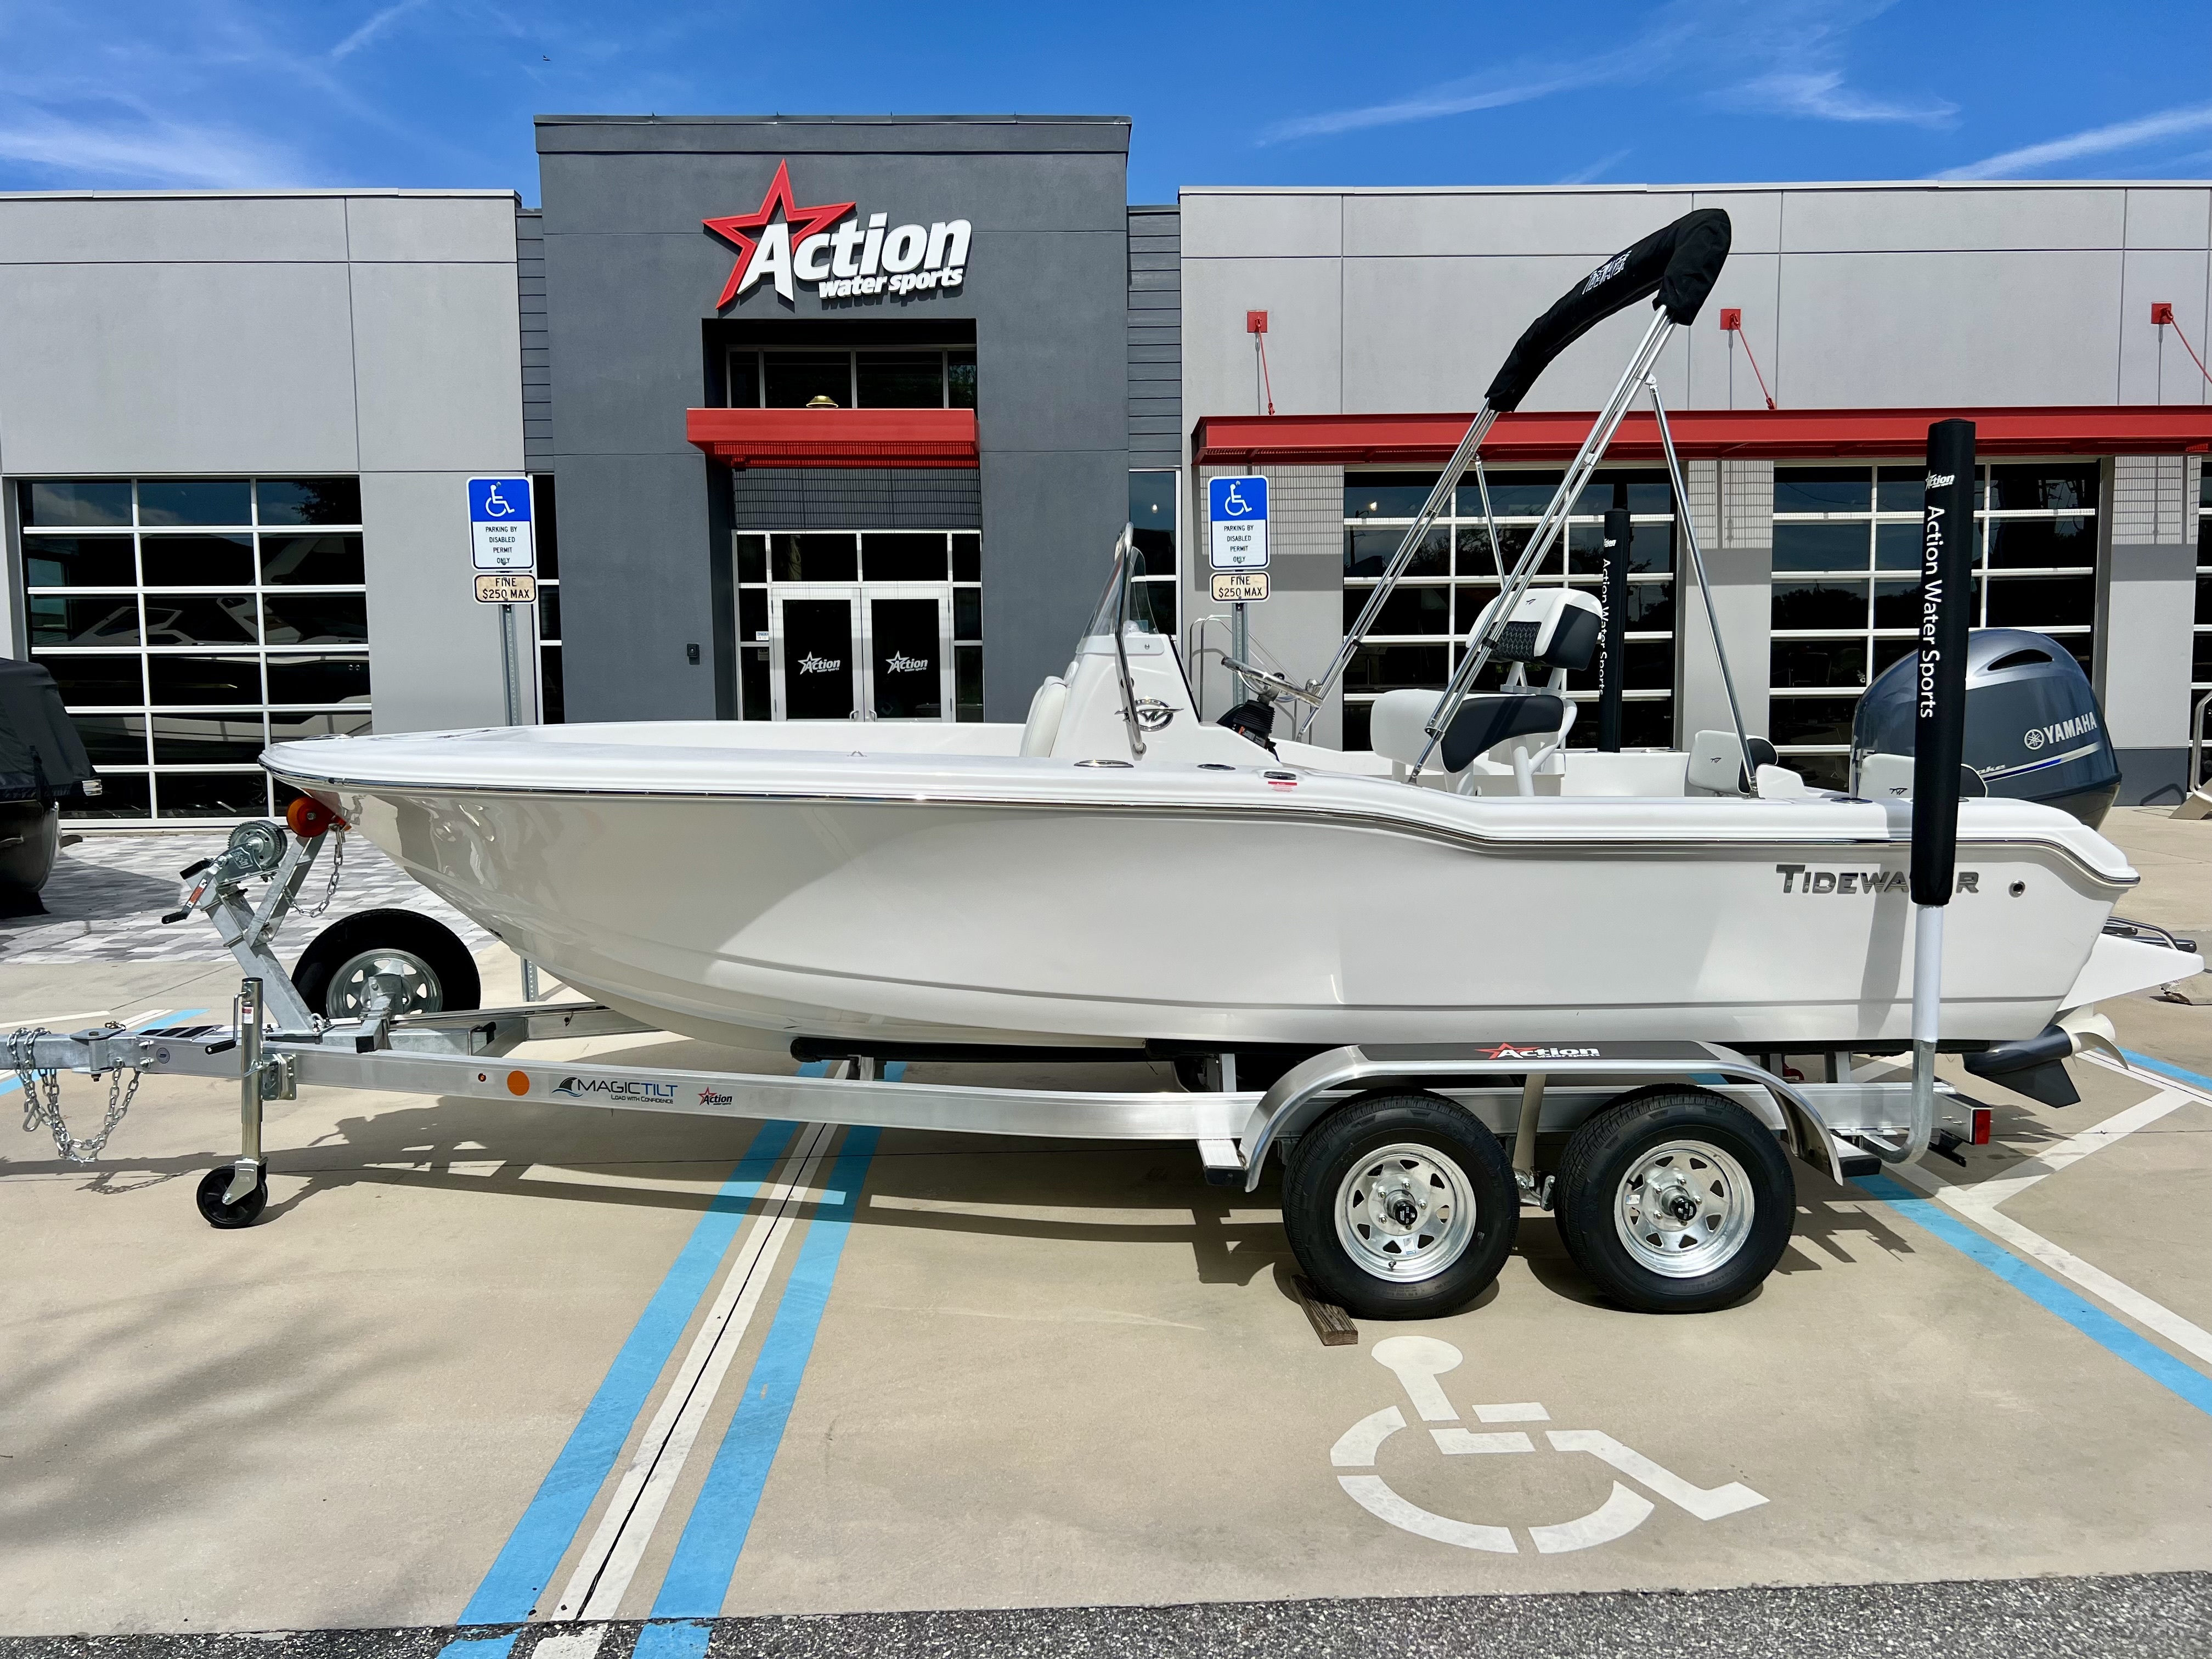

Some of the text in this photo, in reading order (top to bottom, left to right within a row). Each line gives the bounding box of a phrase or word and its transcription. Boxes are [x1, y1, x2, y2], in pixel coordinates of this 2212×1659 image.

[737, 212, 972, 302] Action
[819, 266, 963, 299] water sports
[1925, 505, 1945, 575] Action
[495, 578, 517, 587] FINE
[1231, 576, 1251, 585] FINE
[1601, 558, 1611, 603] Action
[483, 588, 530, 600] $250 MAX
[1218, 587, 1262, 599] $250 MAX
[1922, 579, 1943, 645] Water
[1600, 606, 1610, 649] Water
[803, 659, 840, 673] Action
[891, 658, 928, 673] Action
[1919, 650, 1940, 718] Sports
[2042, 712, 2097, 744] YAMAHA
[1776, 864, 1979, 894] TIDEWAR
[1497, 1048, 1599, 1059] Action
[578, 1079, 678, 1097] MAGICTILT
[702, 1094, 733, 1105] Action
